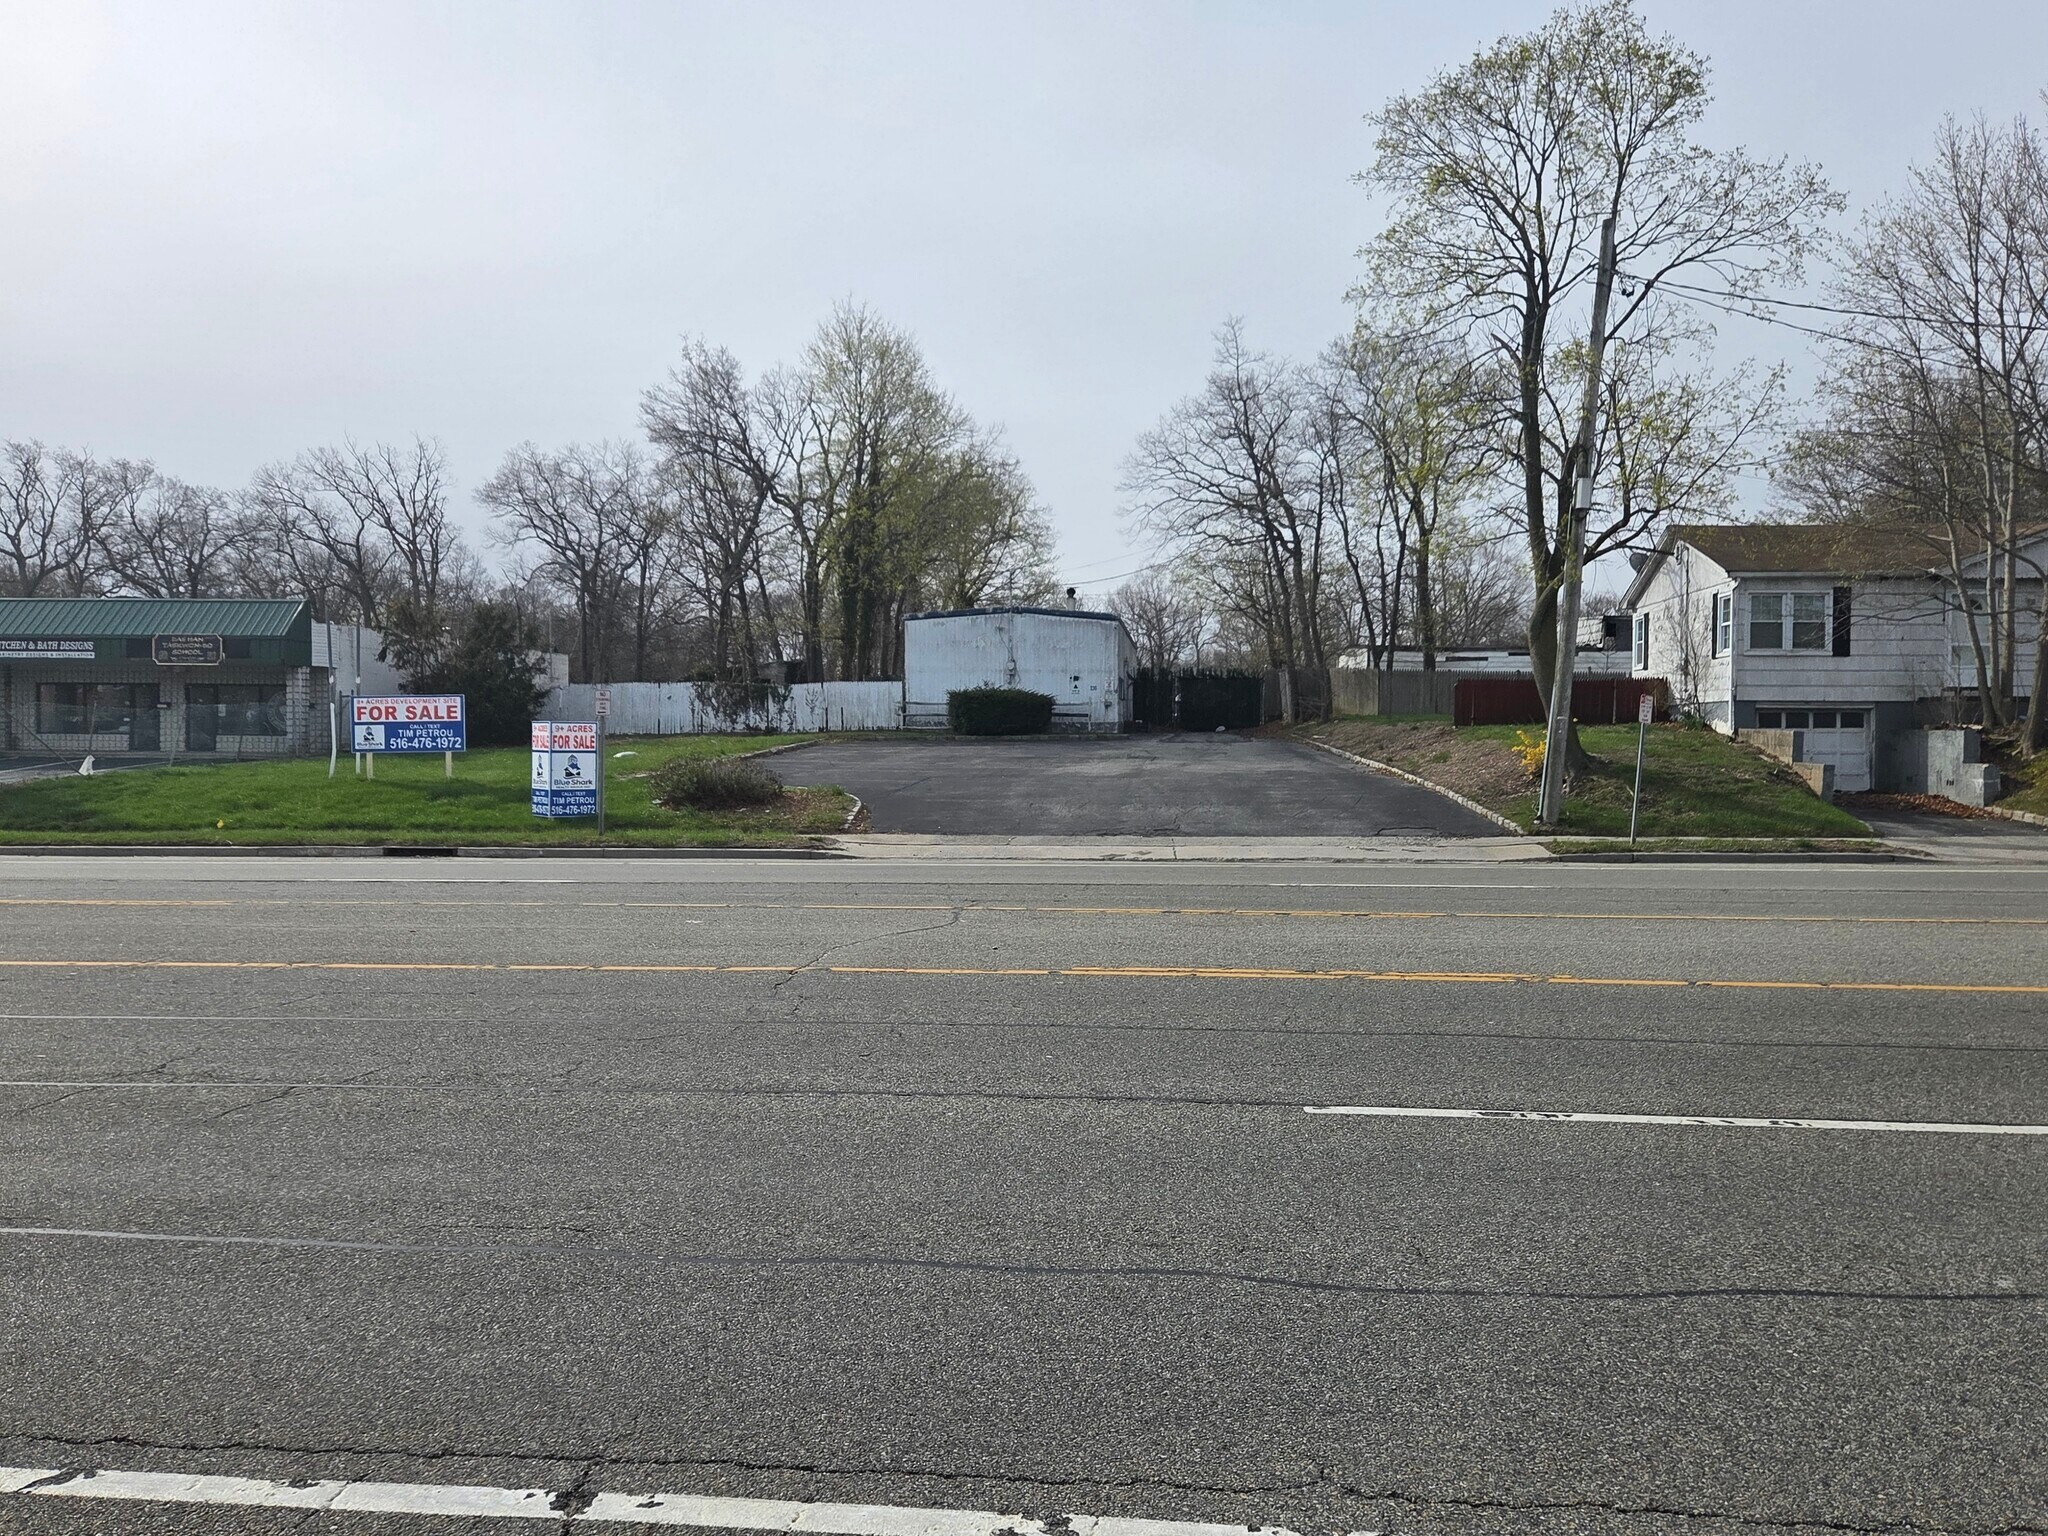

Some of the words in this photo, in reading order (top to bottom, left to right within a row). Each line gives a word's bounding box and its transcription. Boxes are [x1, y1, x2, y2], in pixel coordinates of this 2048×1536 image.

[28, 641, 35, 650] &
[37, 641, 58, 650] BATH
[60, 641, 94, 650] DESIGNS
[356, 706, 398, 720] FOR
[406, 705, 458, 720] SALE
[398, 729, 414, 737] TIM
[416, 729, 453, 737] PETROU
[390, 737, 462, 749] 516-476-1972
[552, 736, 570, 749] FOR
[573, 736, 594, 749] SALE
[552, 806, 596, 814] 516-476-1972
